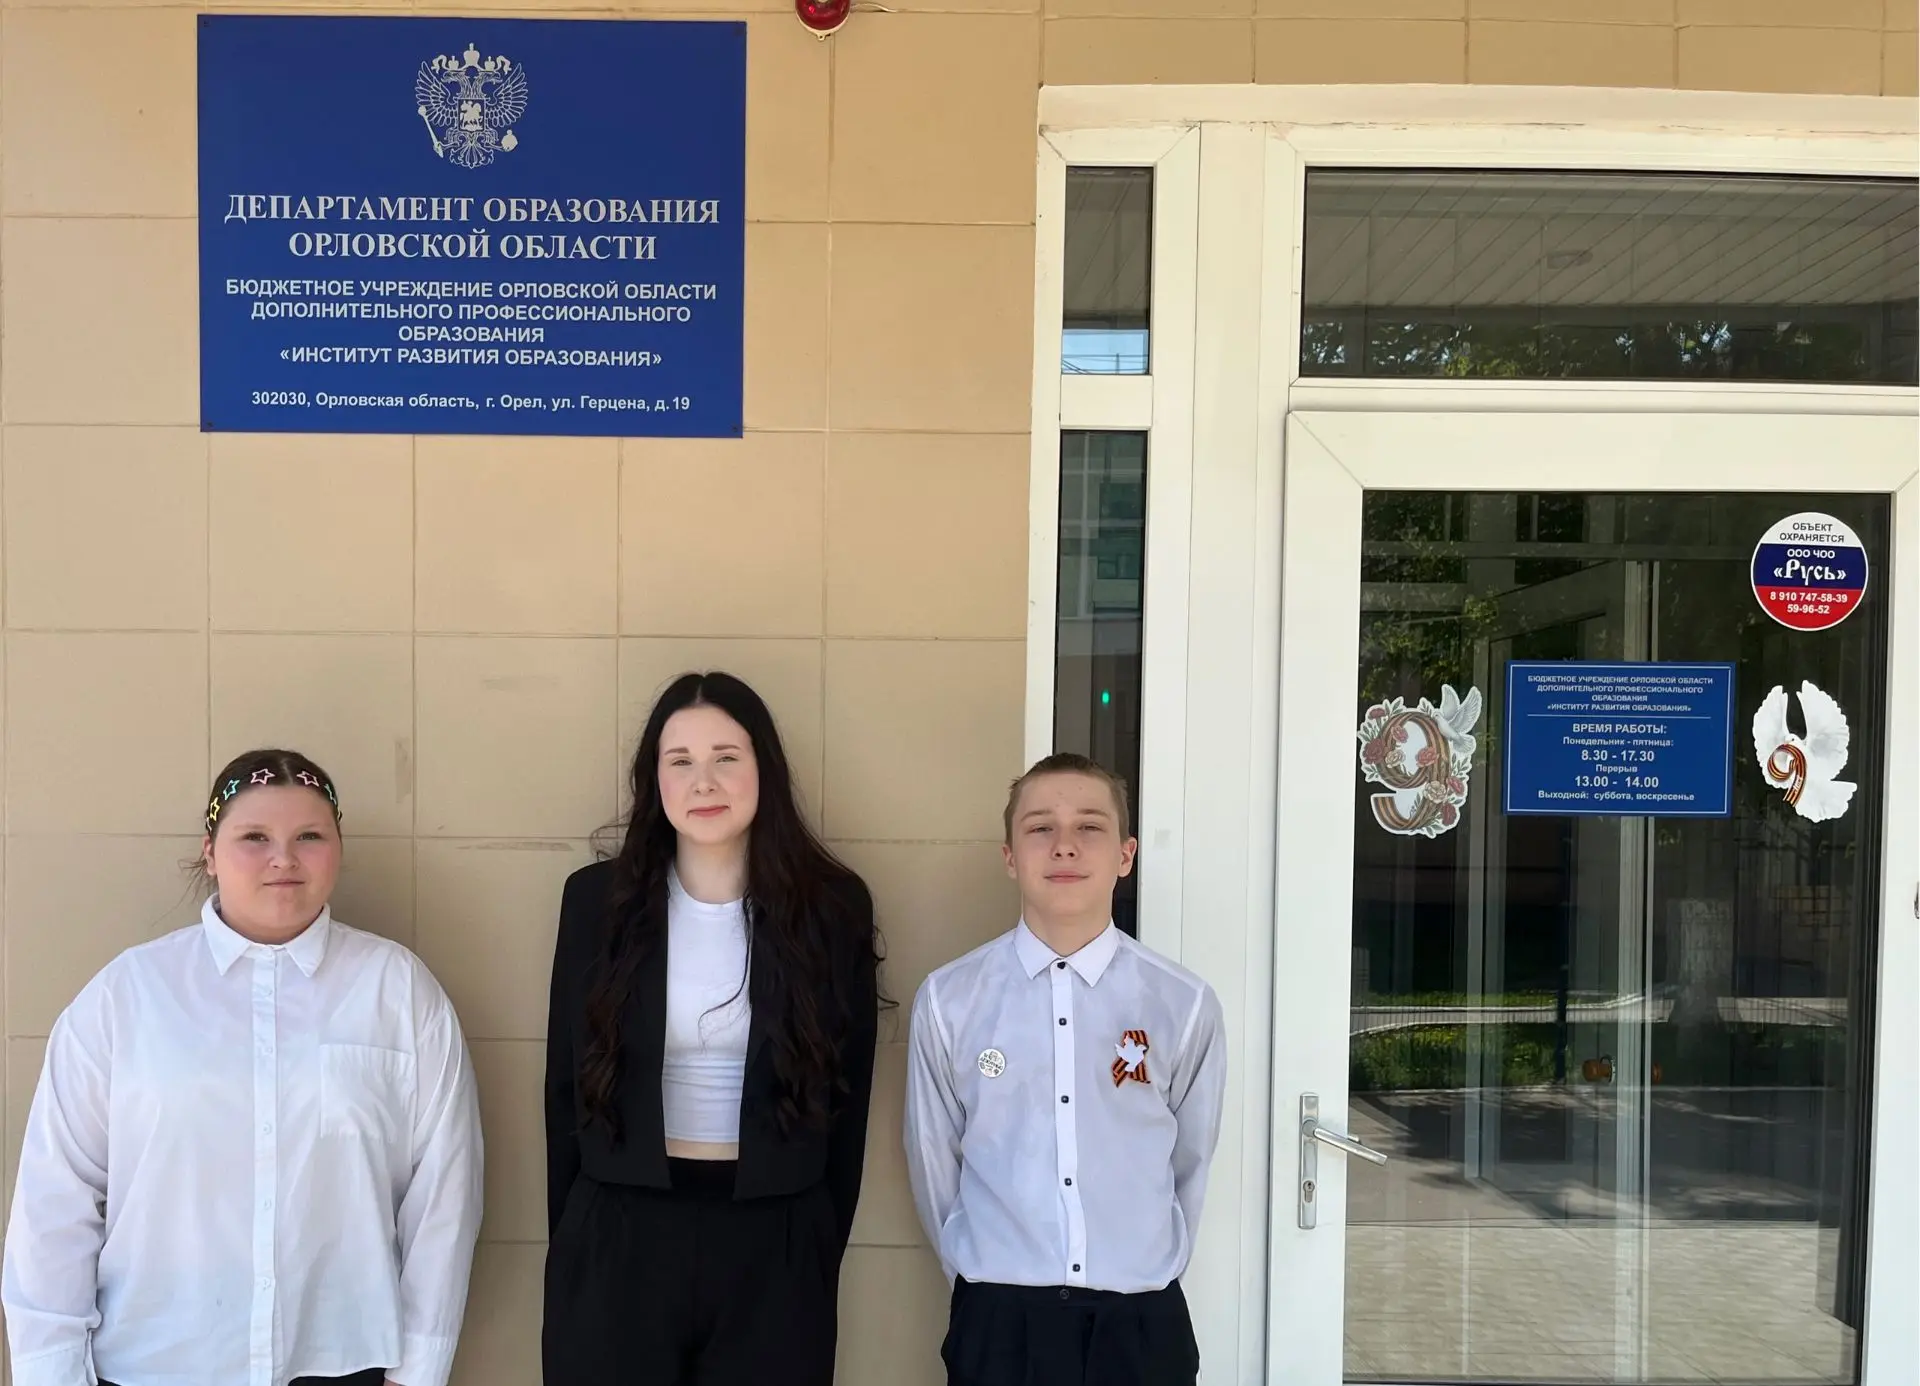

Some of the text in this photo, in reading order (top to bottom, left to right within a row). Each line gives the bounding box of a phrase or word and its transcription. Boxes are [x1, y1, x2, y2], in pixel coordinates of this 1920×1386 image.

[224, 194, 720, 224] ДЕПАРТАМЕНТ ОБРАЗОВАНИЯ
[288, 228, 657, 260] ОРЛОВСКОЙ ОБЛАСТИ
[226, 278, 716, 300] БЮДЖЕТНОЕ УЧРЕЖДЕНИЕ ОРЛОВСКОЙ ОБЛАСТИ
[251, 302, 691, 322] ДОПОЛНИТЕЛЬНОГО ПРОФЕССИОНАЛЬНОГО
[398, 325, 545, 343] ОБРАЗОВАНИЯ
[279, 347, 662, 366] «ИНСТИТУТ РАЗВИТИЯ ОБРАЗОВАНИЯ»
[251, 391, 311, 408] 302030,
[315, 392, 404, 408] Орловская
[408, 394, 480, 410] область,
[485, 397, 496, 408] г.
[500, 394, 547, 411] Орел,
[551, 397, 576, 412] ул.
[580, 395, 651, 412] Герцена,
[1792, 522, 1833, 532] ОБЪЕКТ
[1779, 532, 1845, 543] ОХРАНЯЕТСЯ
[1787, 548, 1836, 559] ООО ЧОО
[1773, 558, 1847, 586] «Русь»
[1769, 591, 1848, 603] 8 910 747-58-39
[1787, 603, 1830, 614] 59-96-52
[1527, 675, 1577, 683] БЮДЖЕТНОЕ
[1578, 676, 1629, 684] УЧРЕЖДЕНИЕ
[1630, 676, 1676, 684] ОРЛОВСКОЙ
[1536, 684, 1704, 694] ДОПОЛНИТЕЛЬНОГО ПРОФЕССИОНАЛЬНОГО
[1591, 694, 1648, 702] ОБРАЗОВАНИЯ
[1547, 703, 1692, 712] «ИНСТИТУТ РАЗВИТИЯ ОБРАЗОВАНИЯ»
[1572, 723, 1668, 734] ВРЕМЯ РАБОТЫ:
[1562, 736, 1625, 746] Понедельник
[1633, 739, 1674, 747] пятница:
[1581, 749, 1608, 761] 8.30
[1620, 750, 1655, 762] 17.30
[1595, 764, 1638, 774] Перерыв
[1574, 775, 1609, 787] 13.00
[1624, 776, 1659, 788] 14.00
[1537, 790, 1695, 801] Выходной: суббота, воскресенье
